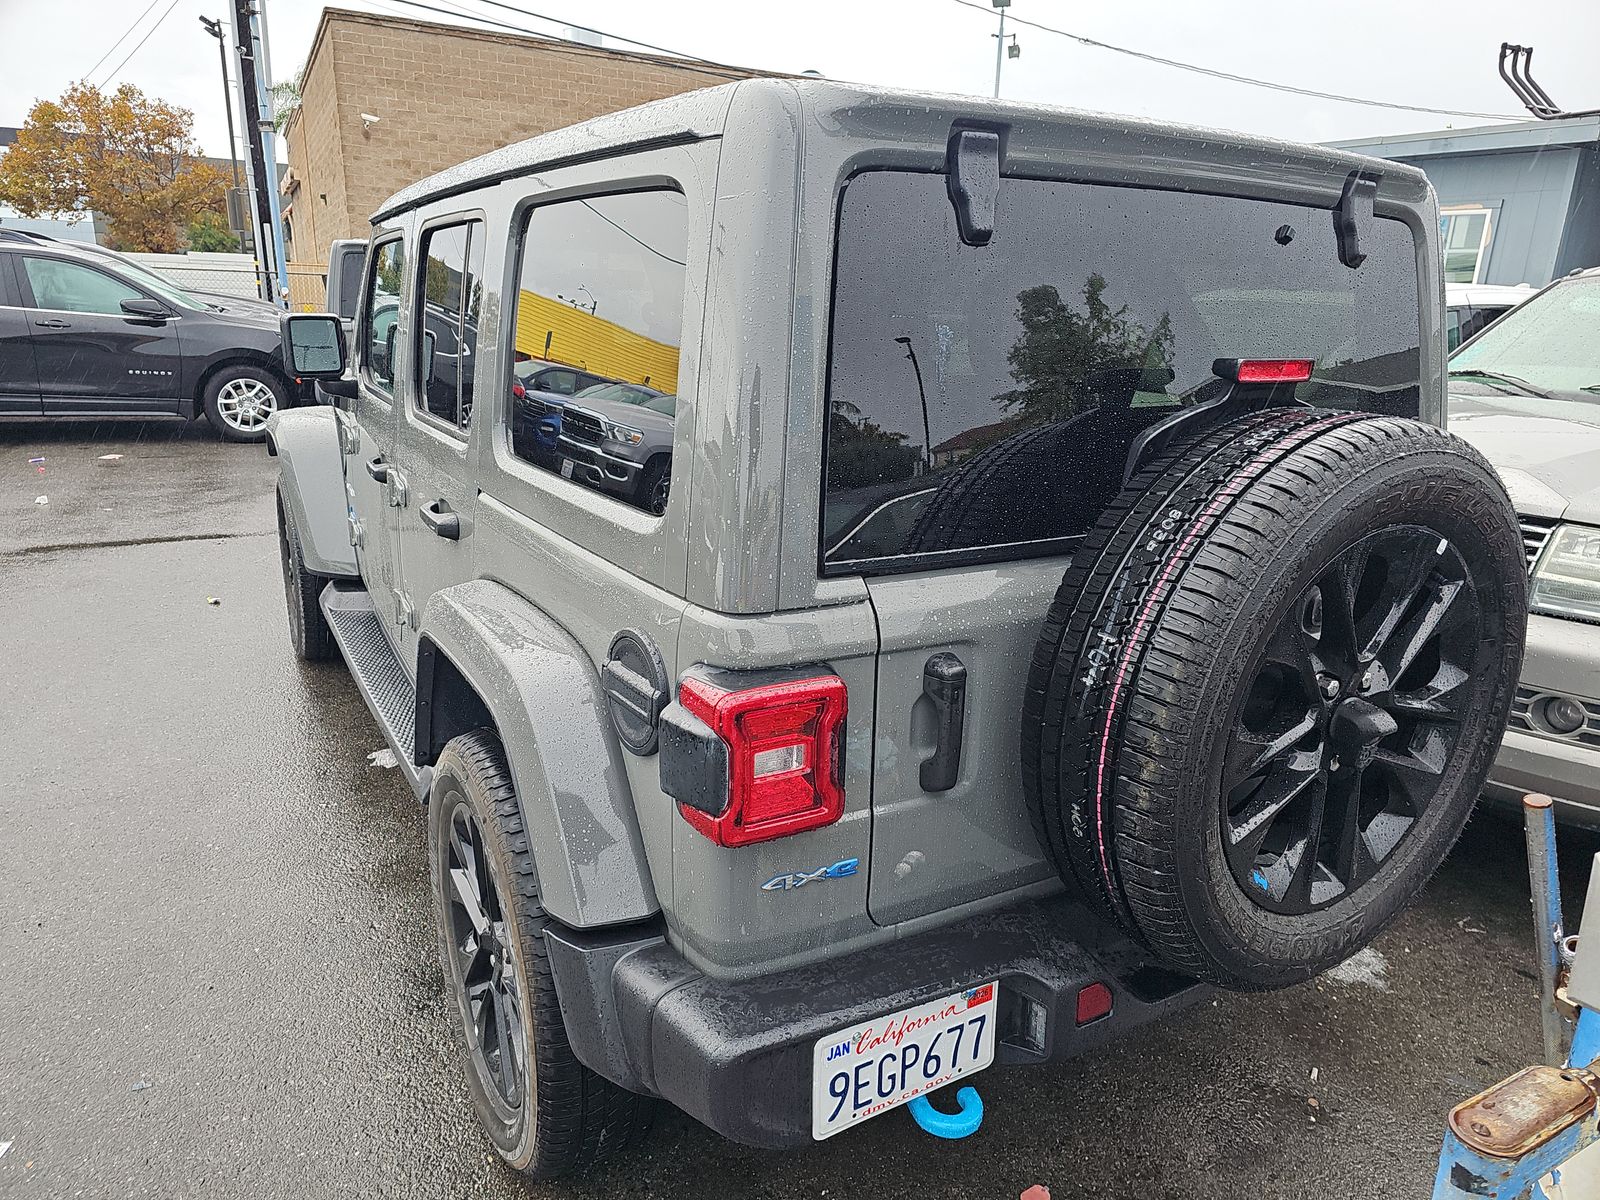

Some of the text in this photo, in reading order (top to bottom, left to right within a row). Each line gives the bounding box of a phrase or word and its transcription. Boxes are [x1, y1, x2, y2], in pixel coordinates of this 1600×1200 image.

[826, 1002, 967, 1062] JAN California
[827, 1014, 987, 1123] 9EGP677
[861, 1072, 953, 1117] dmv.ca.gov
